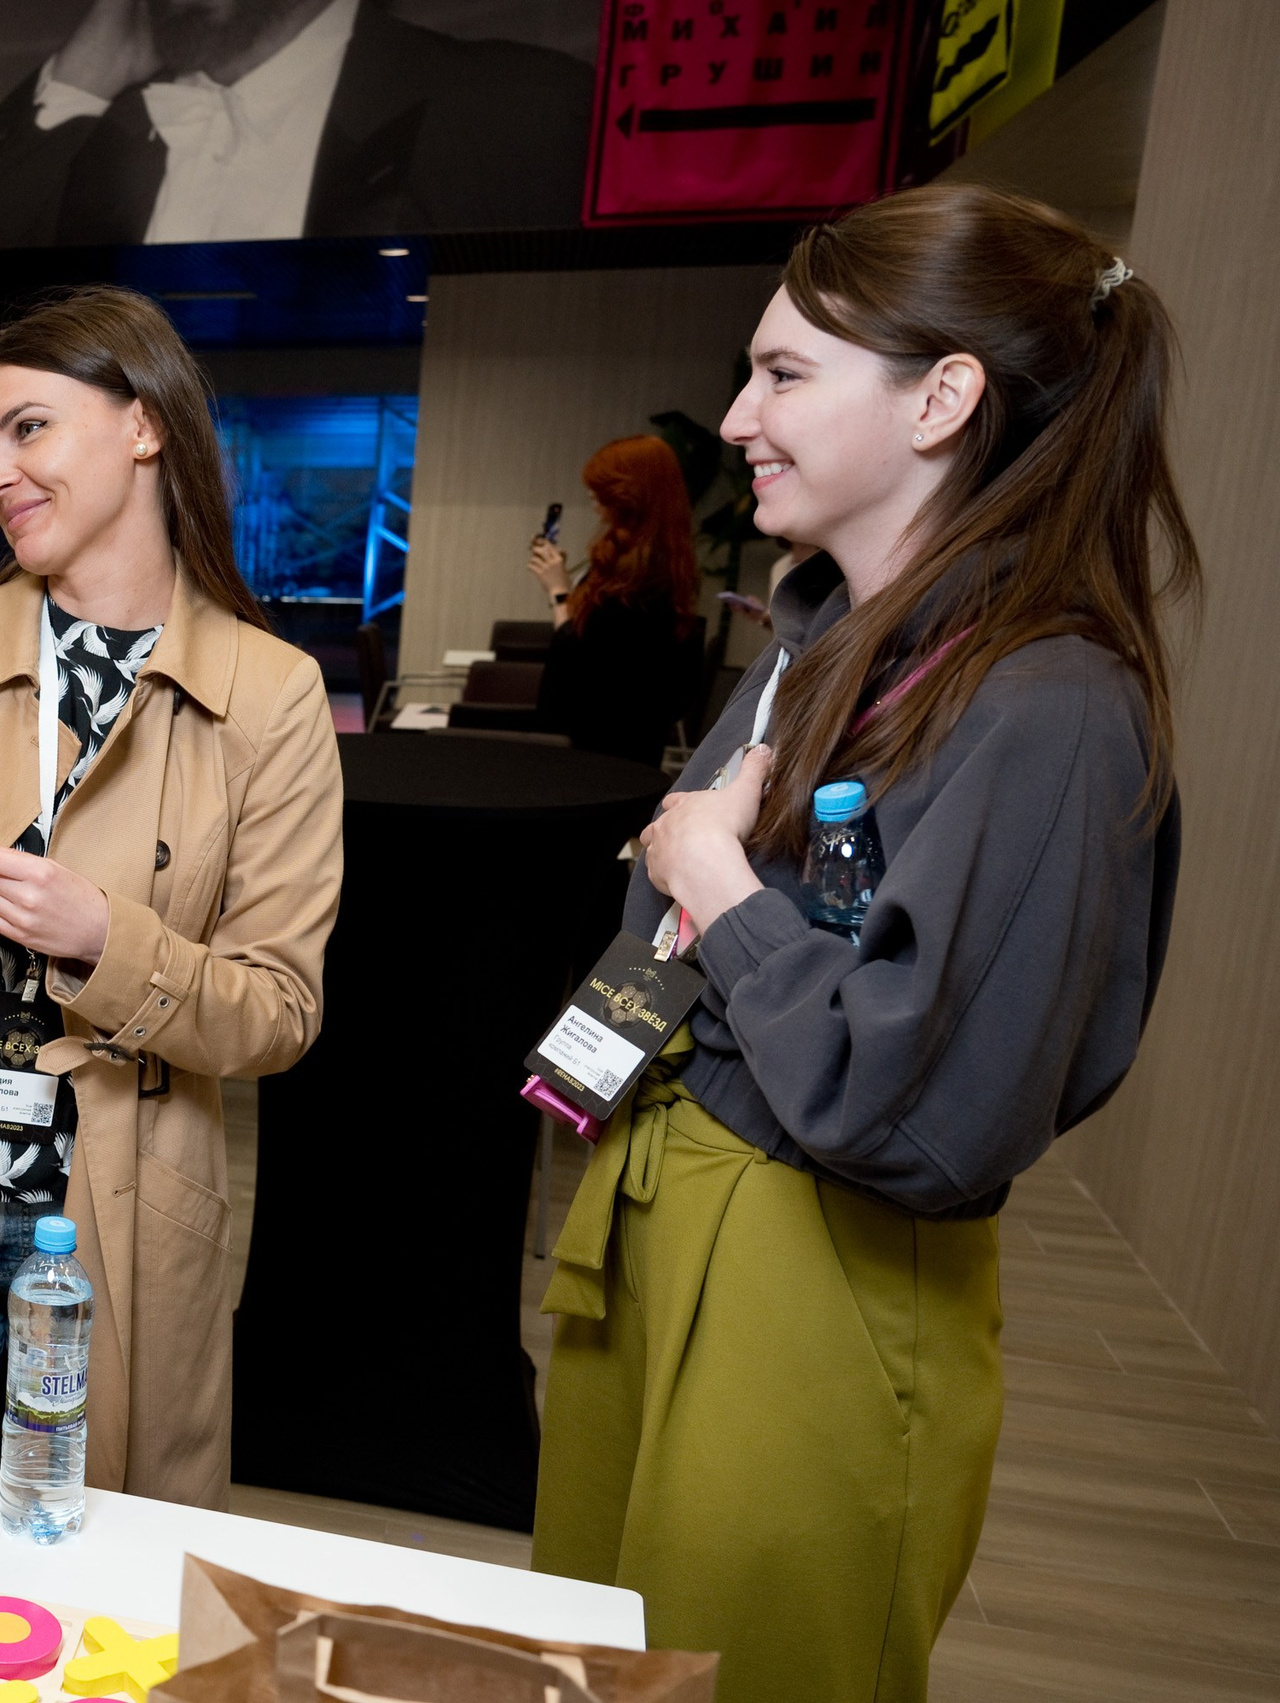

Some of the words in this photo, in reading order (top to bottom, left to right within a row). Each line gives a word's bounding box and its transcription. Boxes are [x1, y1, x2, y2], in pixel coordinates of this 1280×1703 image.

[620, 4, 888, 42] МИХАИЛ
[618, 49, 882, 88] ГРУШИН
[589, 977, 616, 999] MICE
[613, 992, 640, 1014] ВСЕХ
[637, 1008, 668, 1032] ЗВЁЗД
[560, 1024, 598, 1054] Жигалова
[567, 1015, 604, 1043] Ангелина
[5, 1041, 31, 1053] ВСЕХ
[41, 1367, 88, 1396] STELM
